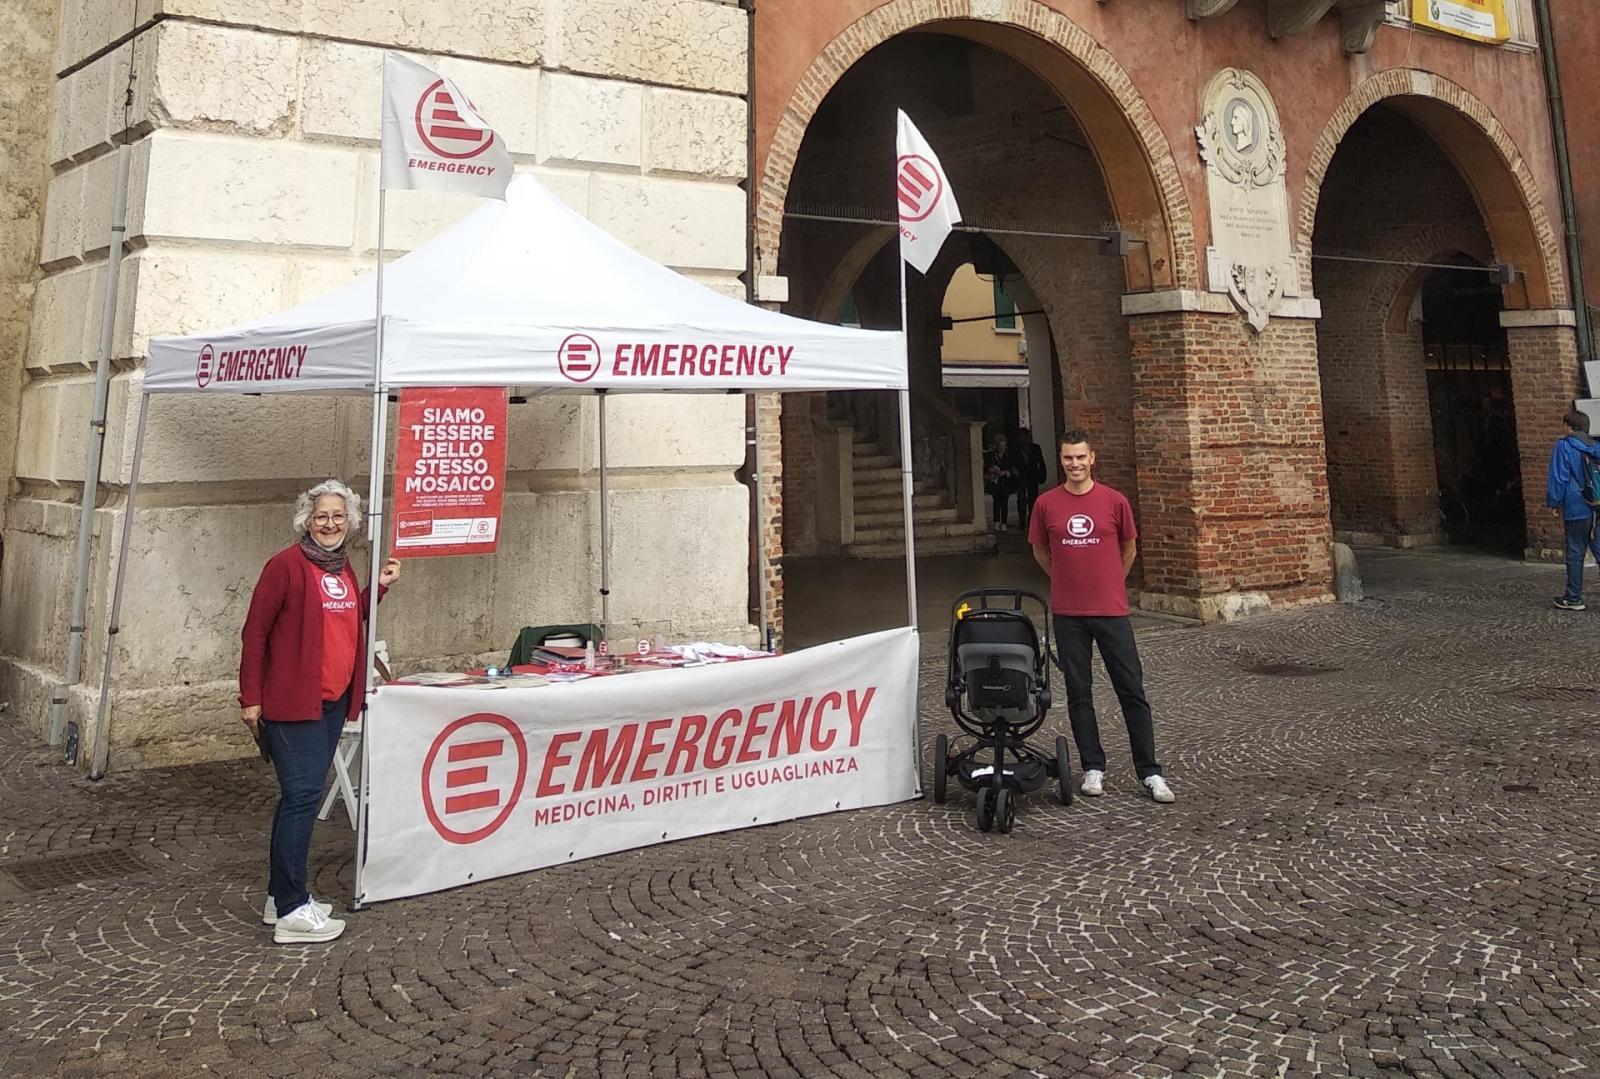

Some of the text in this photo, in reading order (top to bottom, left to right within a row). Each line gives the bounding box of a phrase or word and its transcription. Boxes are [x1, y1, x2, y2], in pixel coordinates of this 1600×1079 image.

[408, 158, 496, 176] EMERGENCY
[216, 345, 308, 382] EMERGENCY
[612, 343, 795, 377] EMERGENCY
[423, 408, 486, 424] SIAMO
[411, 425, 495, 441] TESSERE
[422, 441, 484, 458] DELLO
[414, 458, 489, 475] STESSO
[405, 475, 496, 493] MOSAICO
[322, 601, 356, 610] MERGENCY
[535, 686, 877, 799] EMERGENCY
[534, 756, 859, 827] MEDICINA, DIRITTI E UGUAGLIANZA
